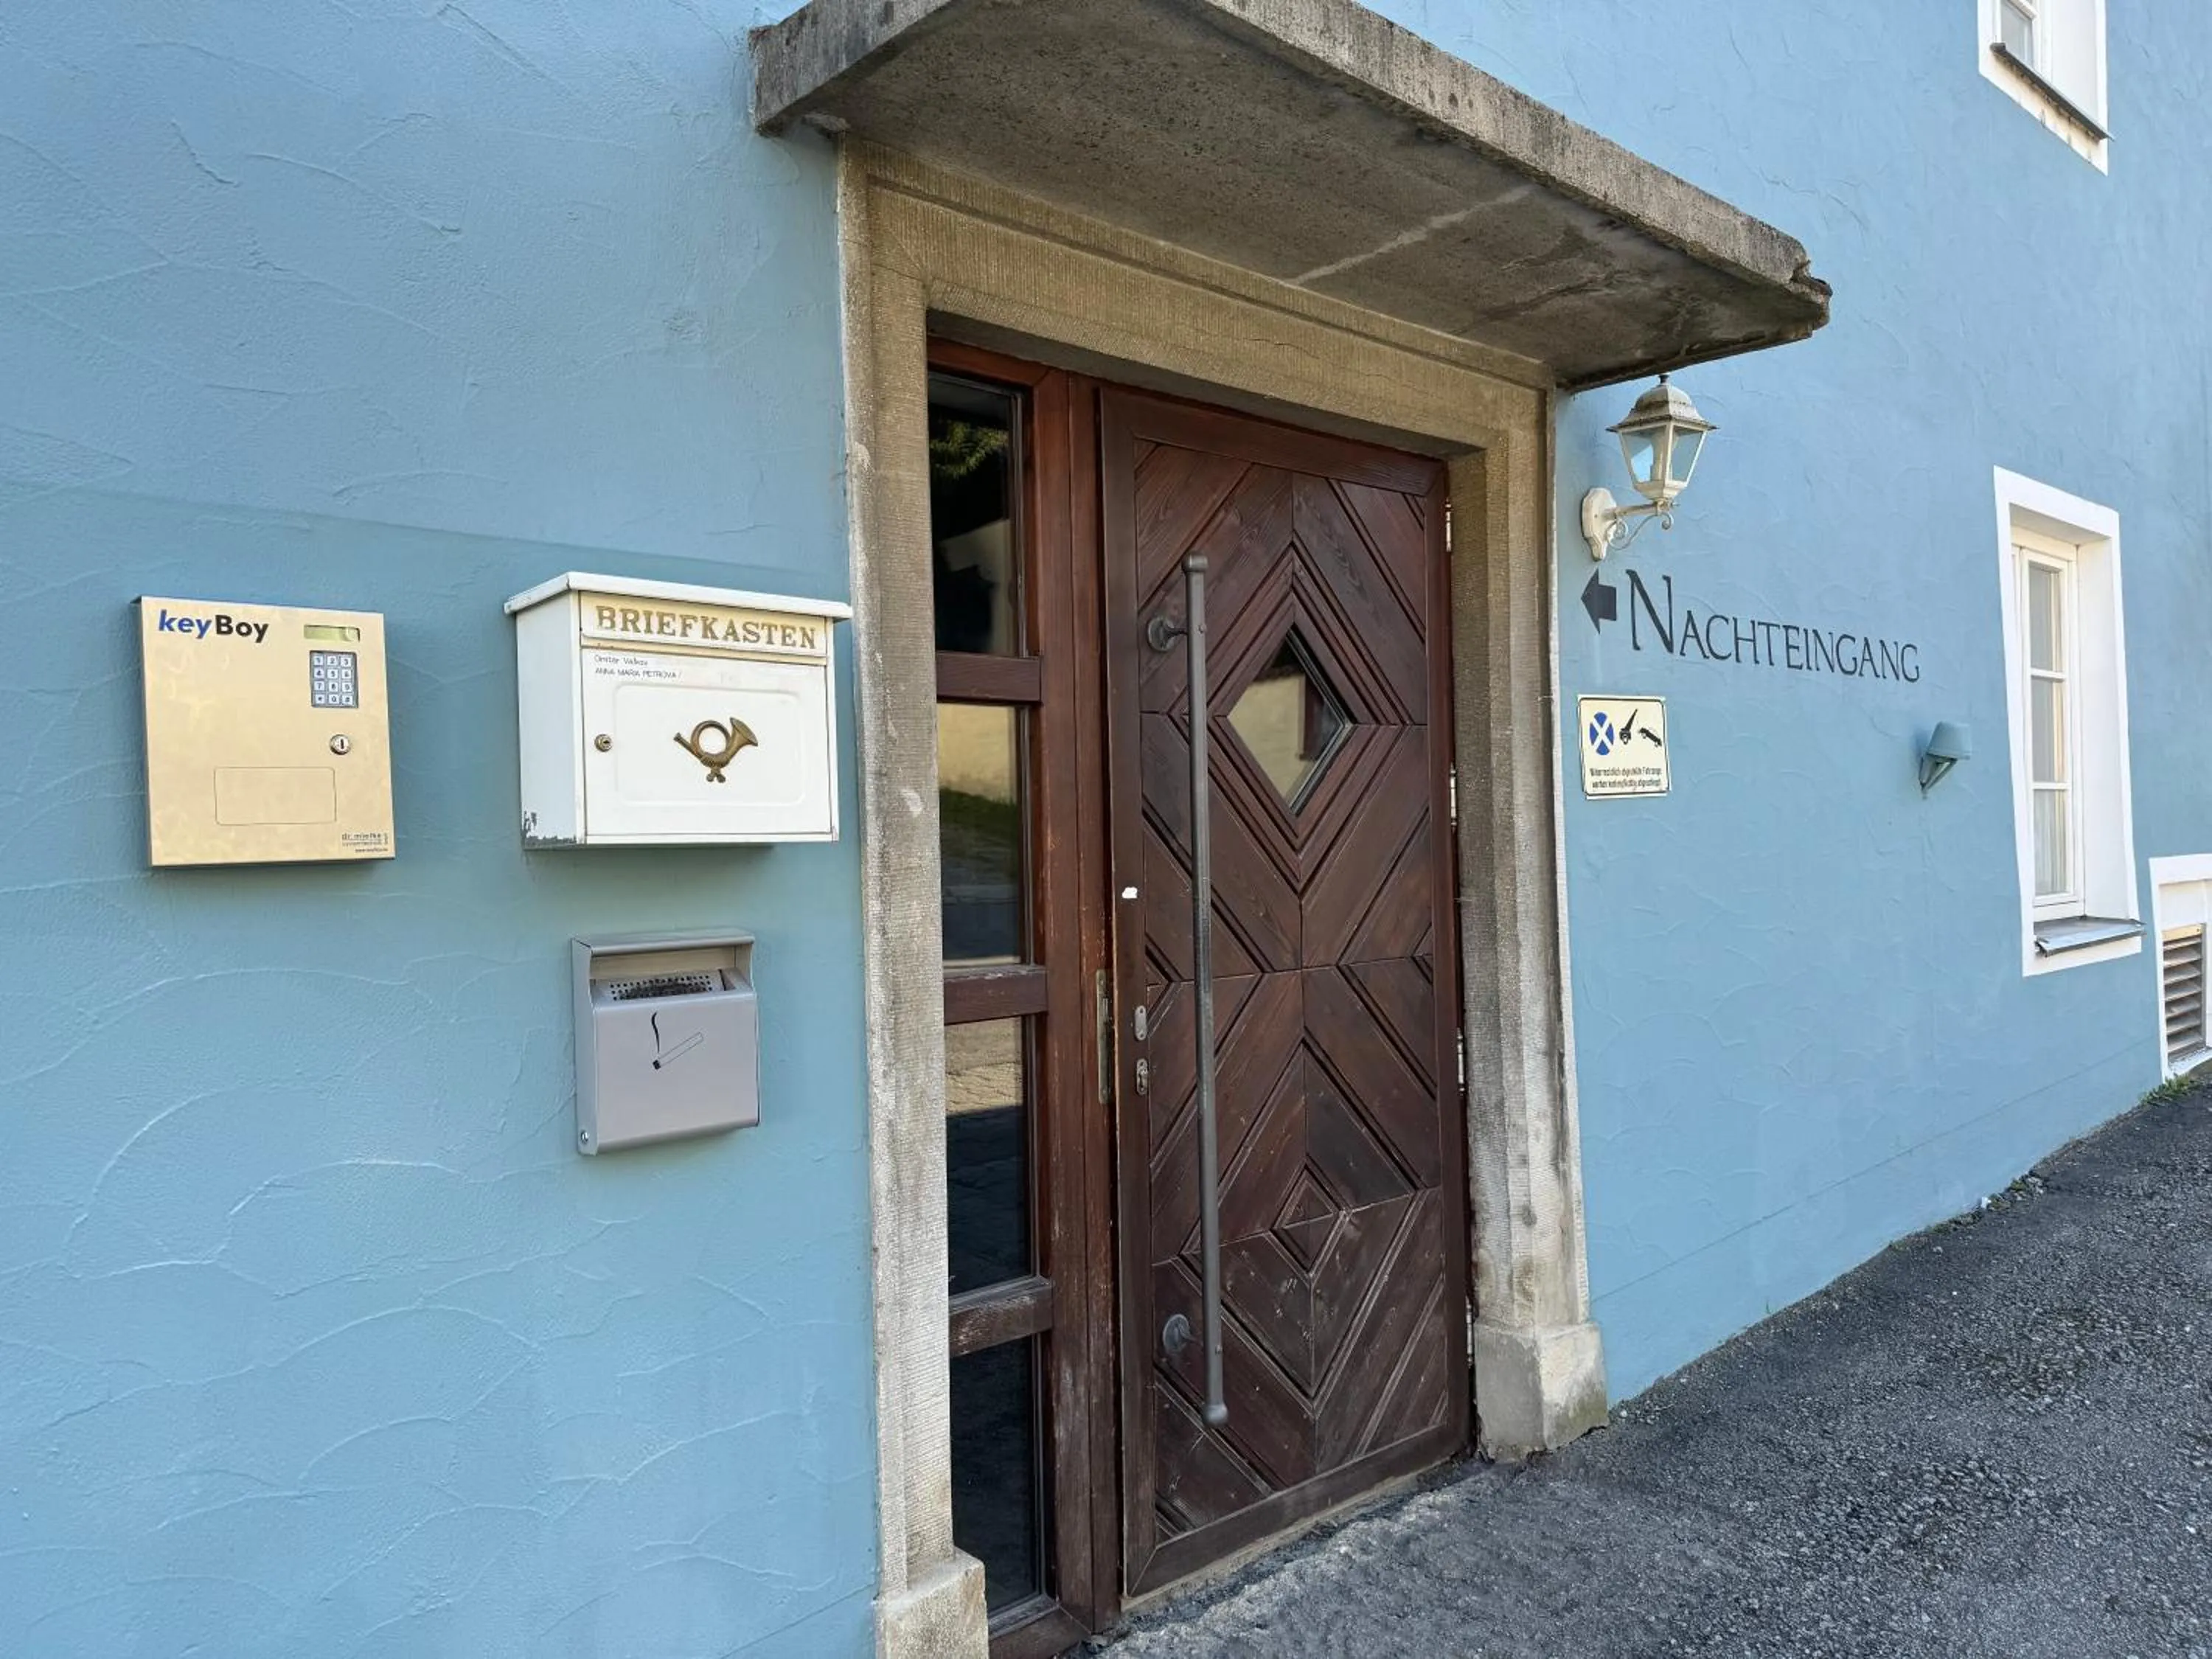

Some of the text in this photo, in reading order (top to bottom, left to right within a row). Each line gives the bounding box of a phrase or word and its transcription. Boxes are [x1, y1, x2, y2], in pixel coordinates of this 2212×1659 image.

[158, 609, 269, 643] keyBoy
[596, 605, 816, 649] BRIEFKASTEN
[1626, 569, 1920, 683] NACHTEINGANG
